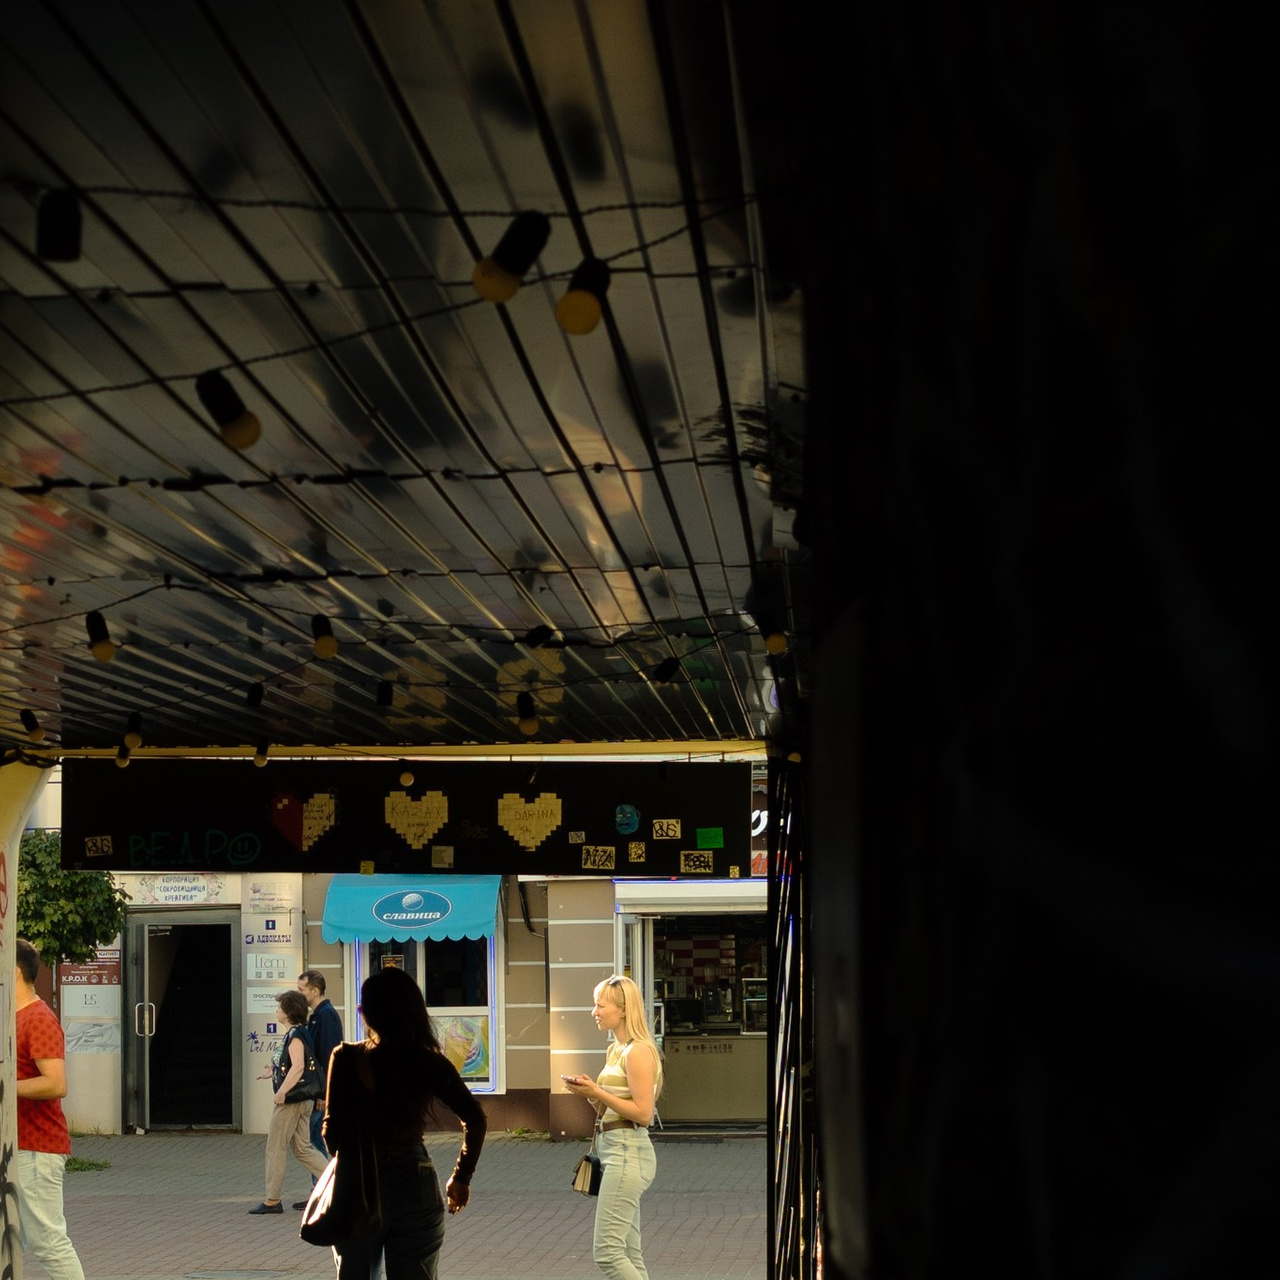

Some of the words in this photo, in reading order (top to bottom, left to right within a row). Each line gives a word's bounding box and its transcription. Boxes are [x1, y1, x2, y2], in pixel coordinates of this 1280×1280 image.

[514, 808, 555, 821] DARINA
[382, 911, 441, 921] славица
[256, 934, 292, 943] АДВОКАТЫ
